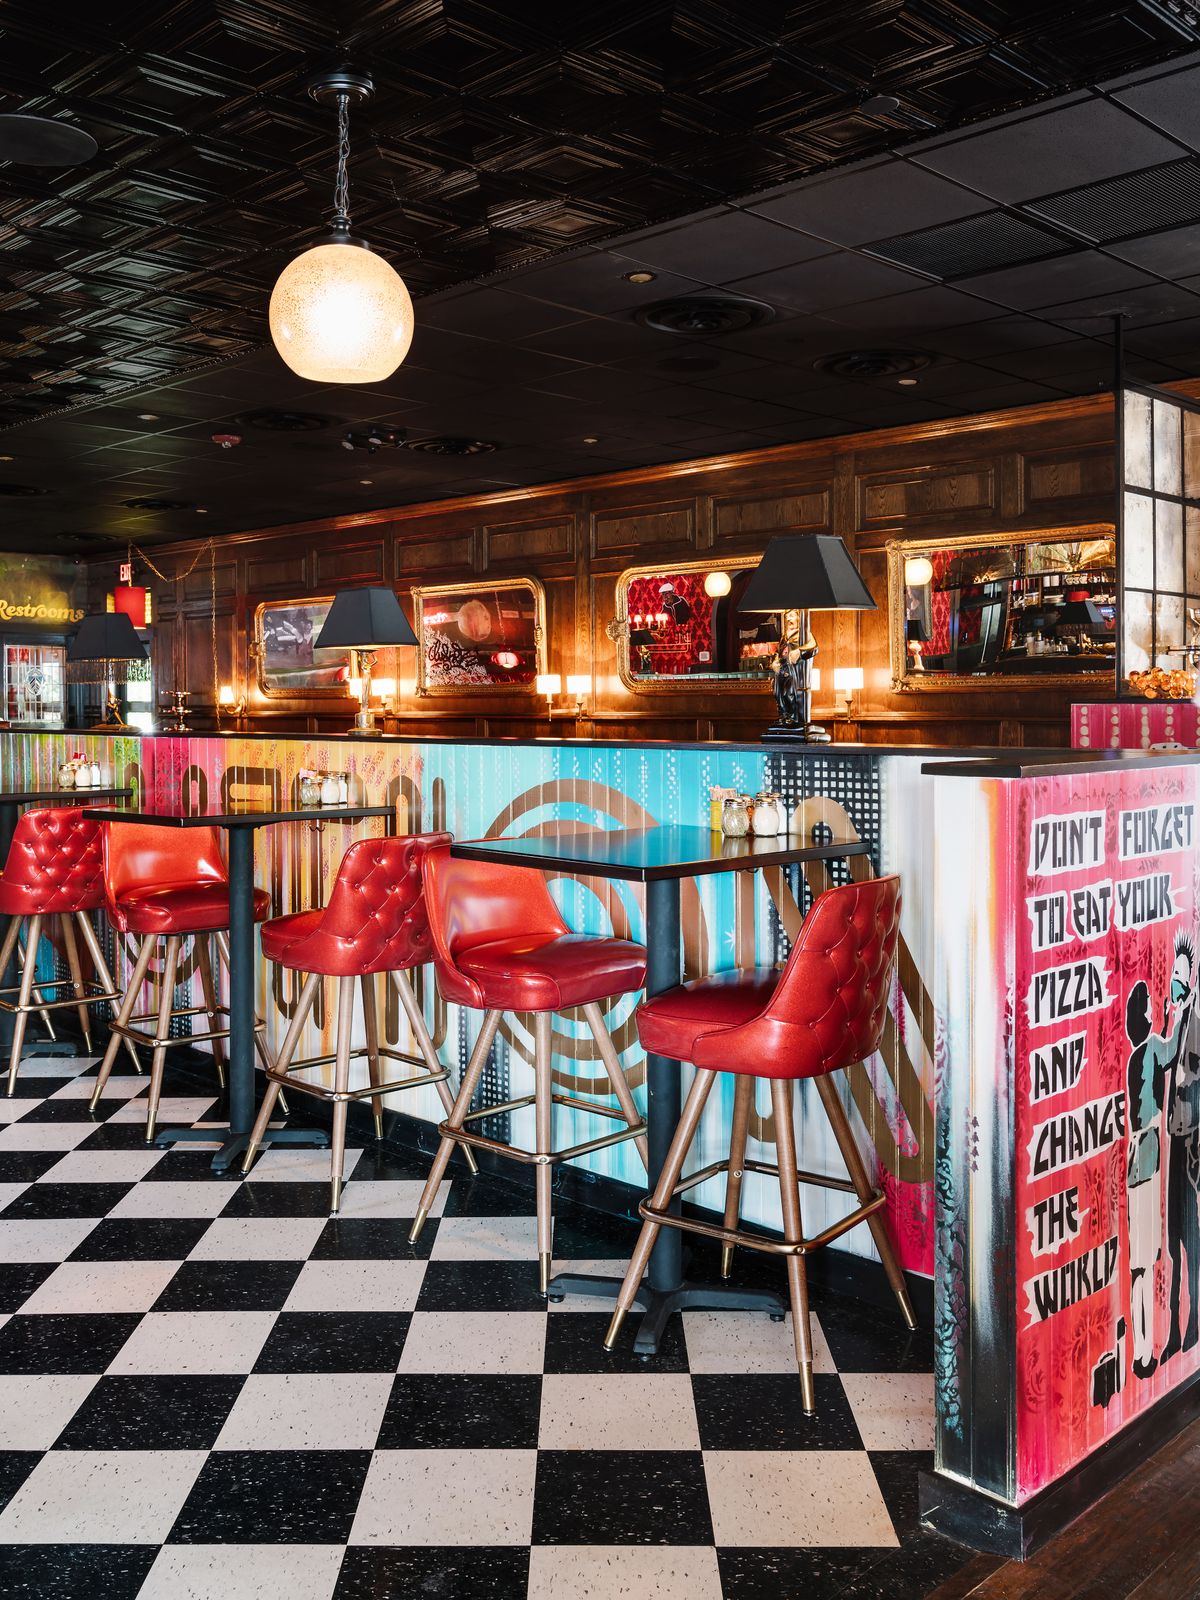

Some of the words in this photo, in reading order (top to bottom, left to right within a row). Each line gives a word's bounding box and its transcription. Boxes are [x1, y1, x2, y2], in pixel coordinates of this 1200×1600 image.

[0, 599, 85, 623] Restrooms
[1034, 816, 1103, 872] DON'T
[1122, 804, 1194, 857] FORGET
[1033, 895, 1065, 947] TO
[1072, 884, 1112, 937] EAT
[1117, 873, 1173, 928] YOUR
[1034, 961, 1104, 1024] PIZZA
[1034, 1036, 1085, 1100] AND
[1033, 1091, 1126, 1176] CHANGE
[1033, 1185, 1079, 1251] THE
[1033, 1235, 1119, 1322] WORLD
